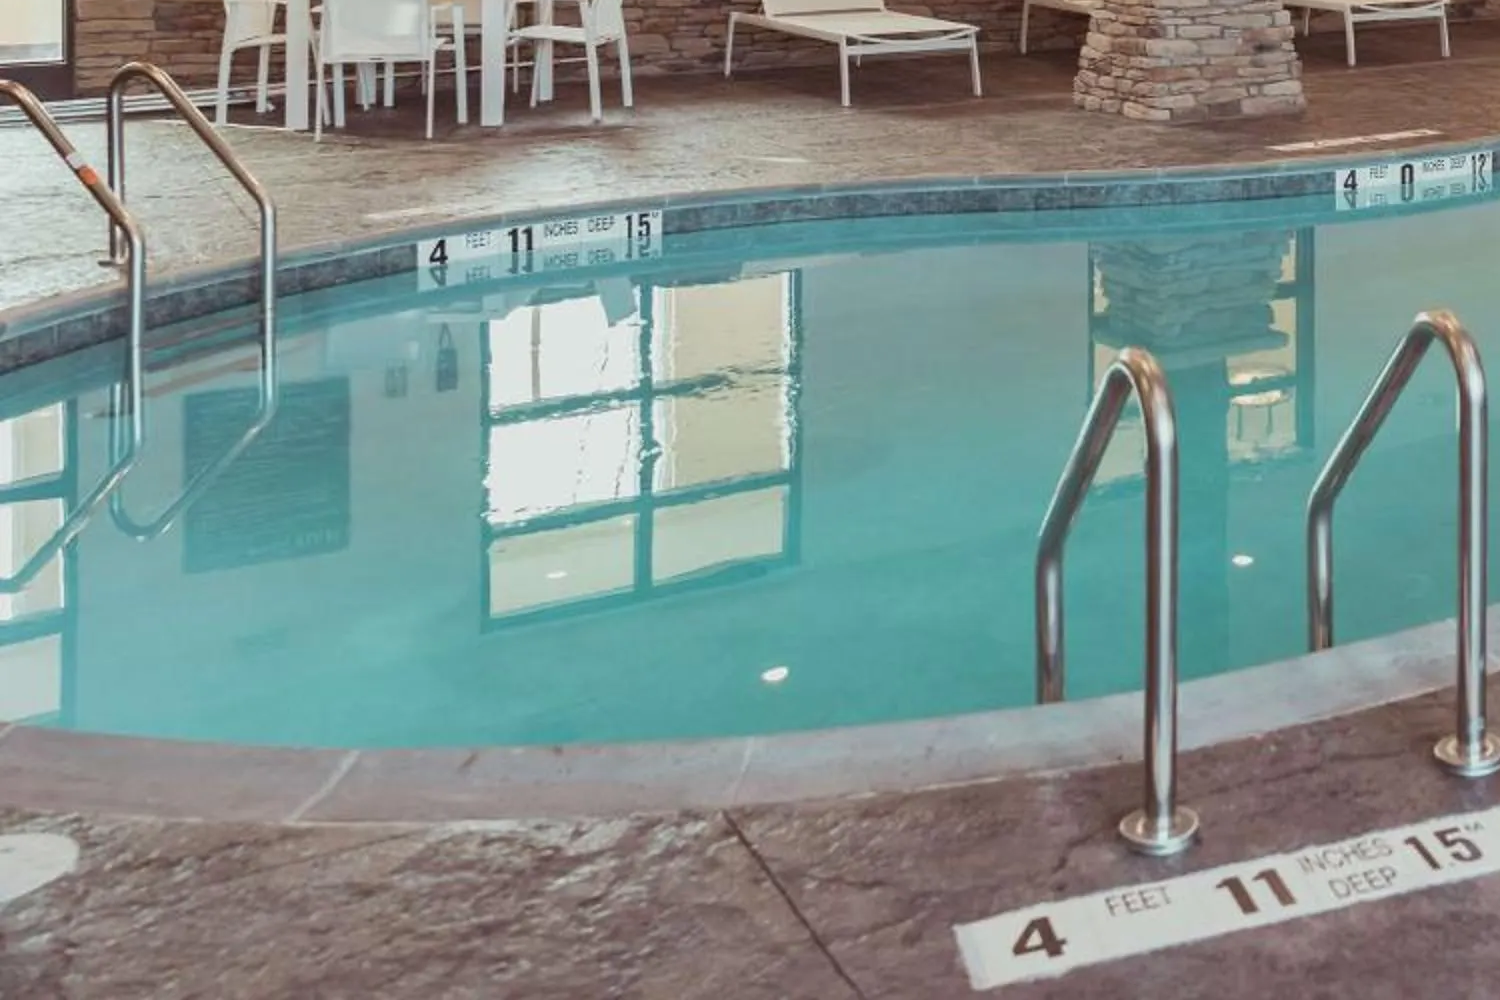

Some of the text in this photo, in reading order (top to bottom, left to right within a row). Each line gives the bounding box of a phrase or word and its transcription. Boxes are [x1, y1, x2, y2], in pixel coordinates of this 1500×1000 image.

[1344, 170, 1359, 190] 4
[429, 239, 448, 265] 4
[507, 226, 533, 252] 11
[1296, 837, 1393, 873] INCHES
[1215, 868, 1297, 915] 11
[1328, 866, 1399, 900] DEEP
[1104, 886, 1172, 917] FEET
[1012, 916, 1067, 957] 4
